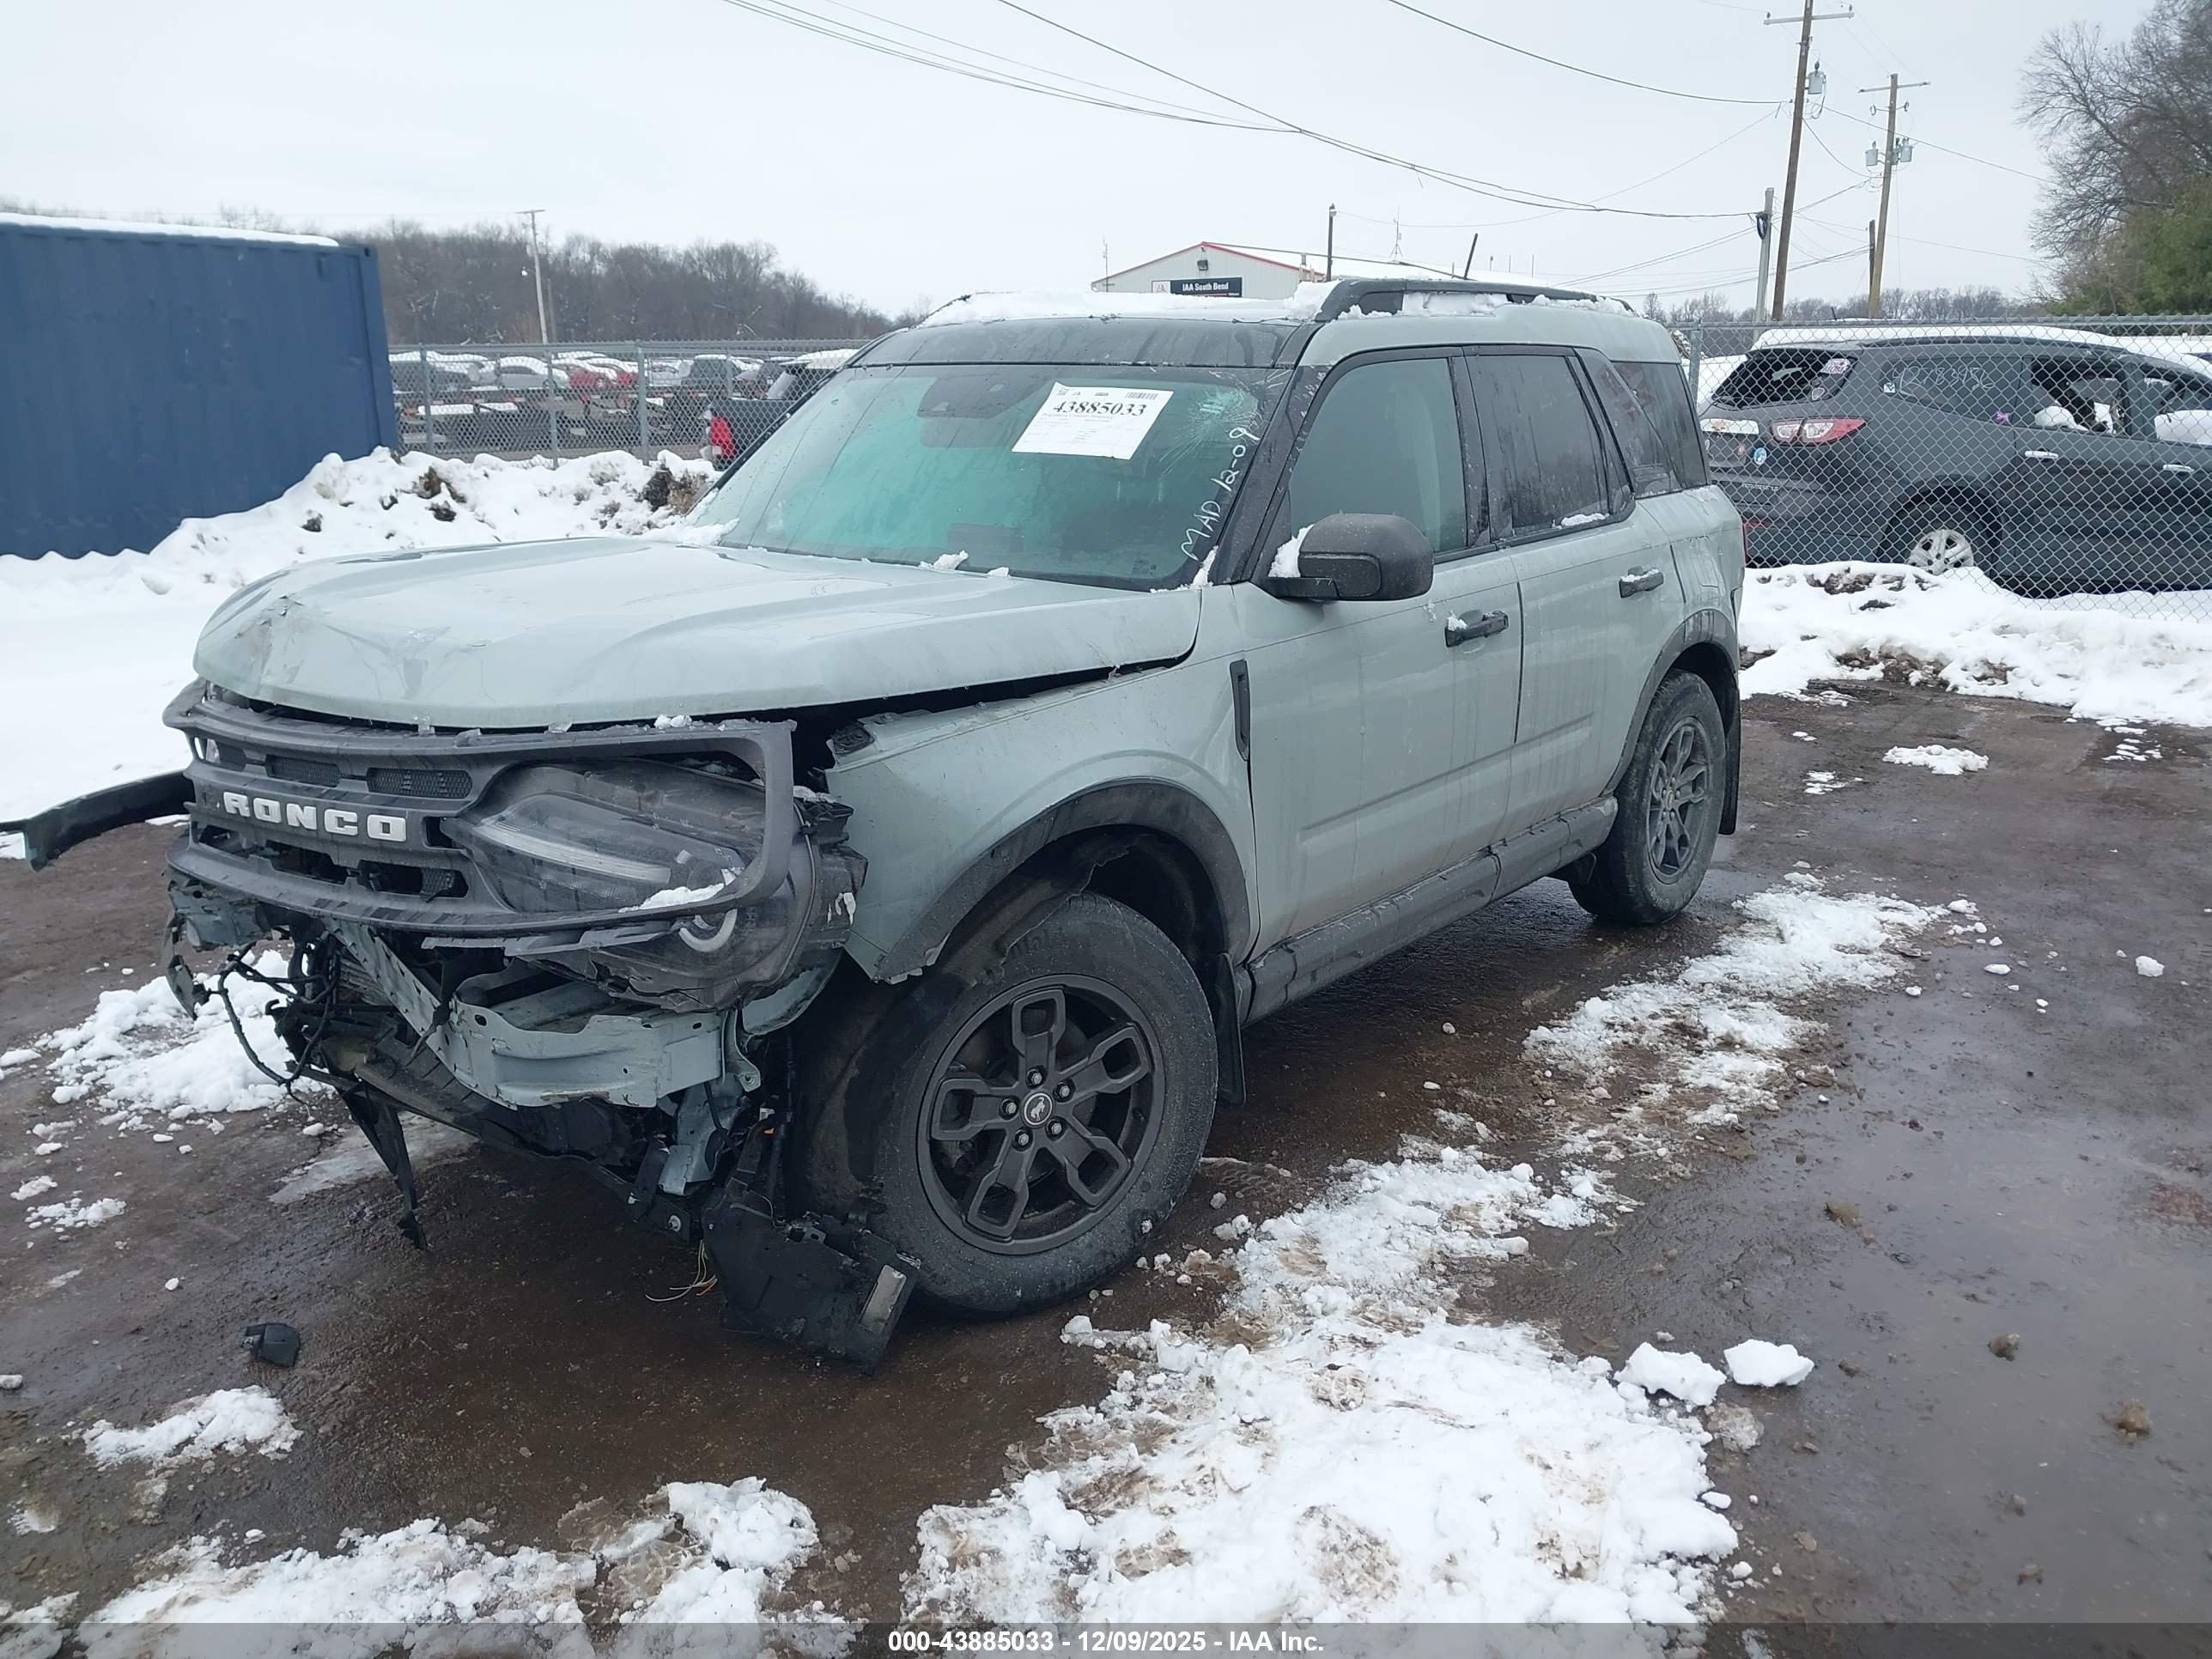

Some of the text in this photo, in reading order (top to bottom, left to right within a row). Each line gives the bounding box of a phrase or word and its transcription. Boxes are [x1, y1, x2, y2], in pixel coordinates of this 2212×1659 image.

[1182, 282, 1229, 292] IAA South Bend
[1053, 399, 1147, 416] 43885033
[1181, 501, 1221, 561] MAD
[223, 791, 407, 842] RONCO
